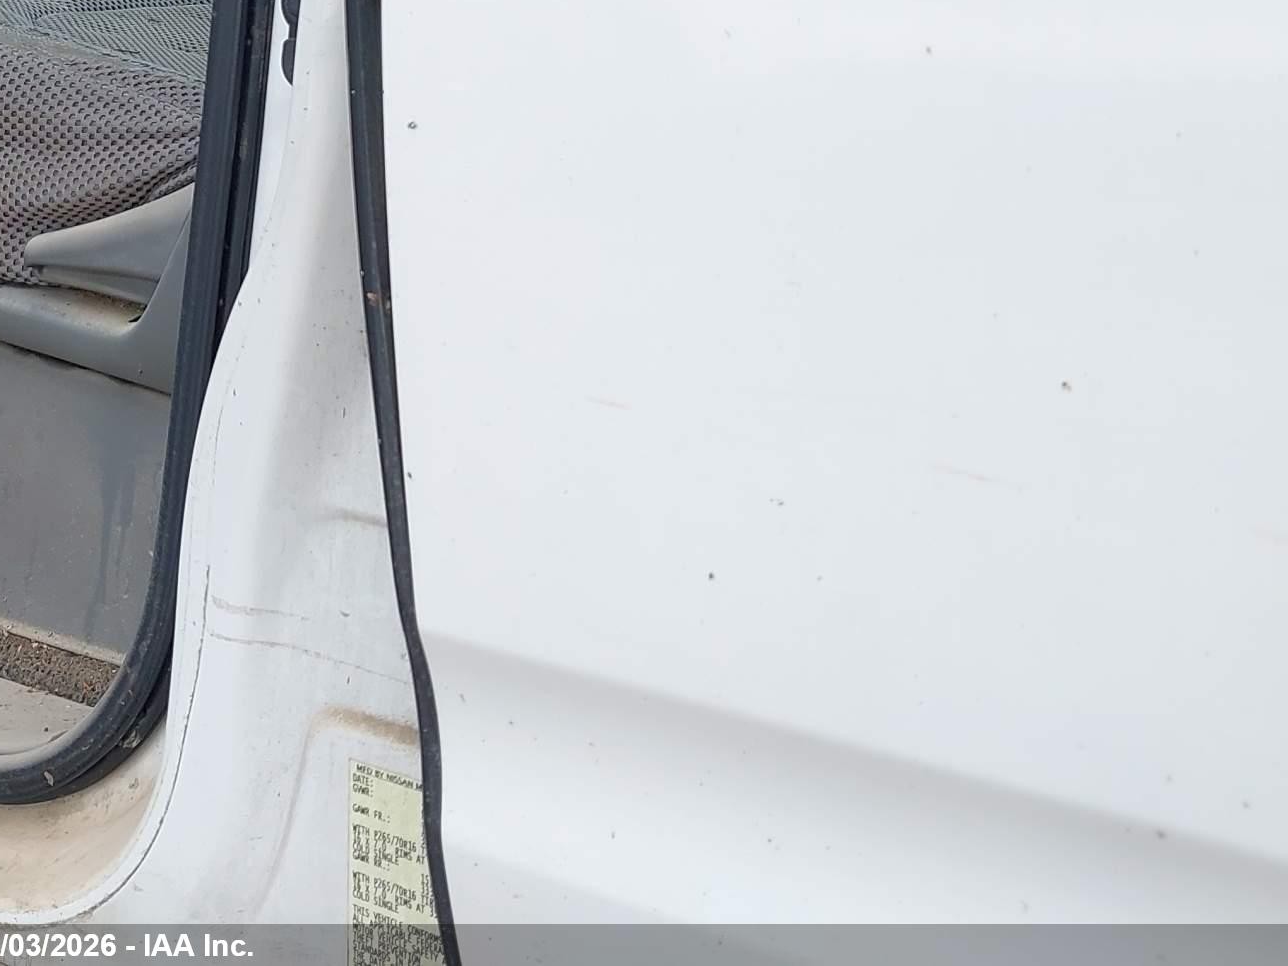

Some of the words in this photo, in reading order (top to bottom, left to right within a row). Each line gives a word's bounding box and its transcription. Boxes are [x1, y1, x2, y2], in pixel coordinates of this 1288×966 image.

[352, 773, 373, 787] DATE:
[415, 855, 424, 864] AT
[415, 904, 424, 913] AT
